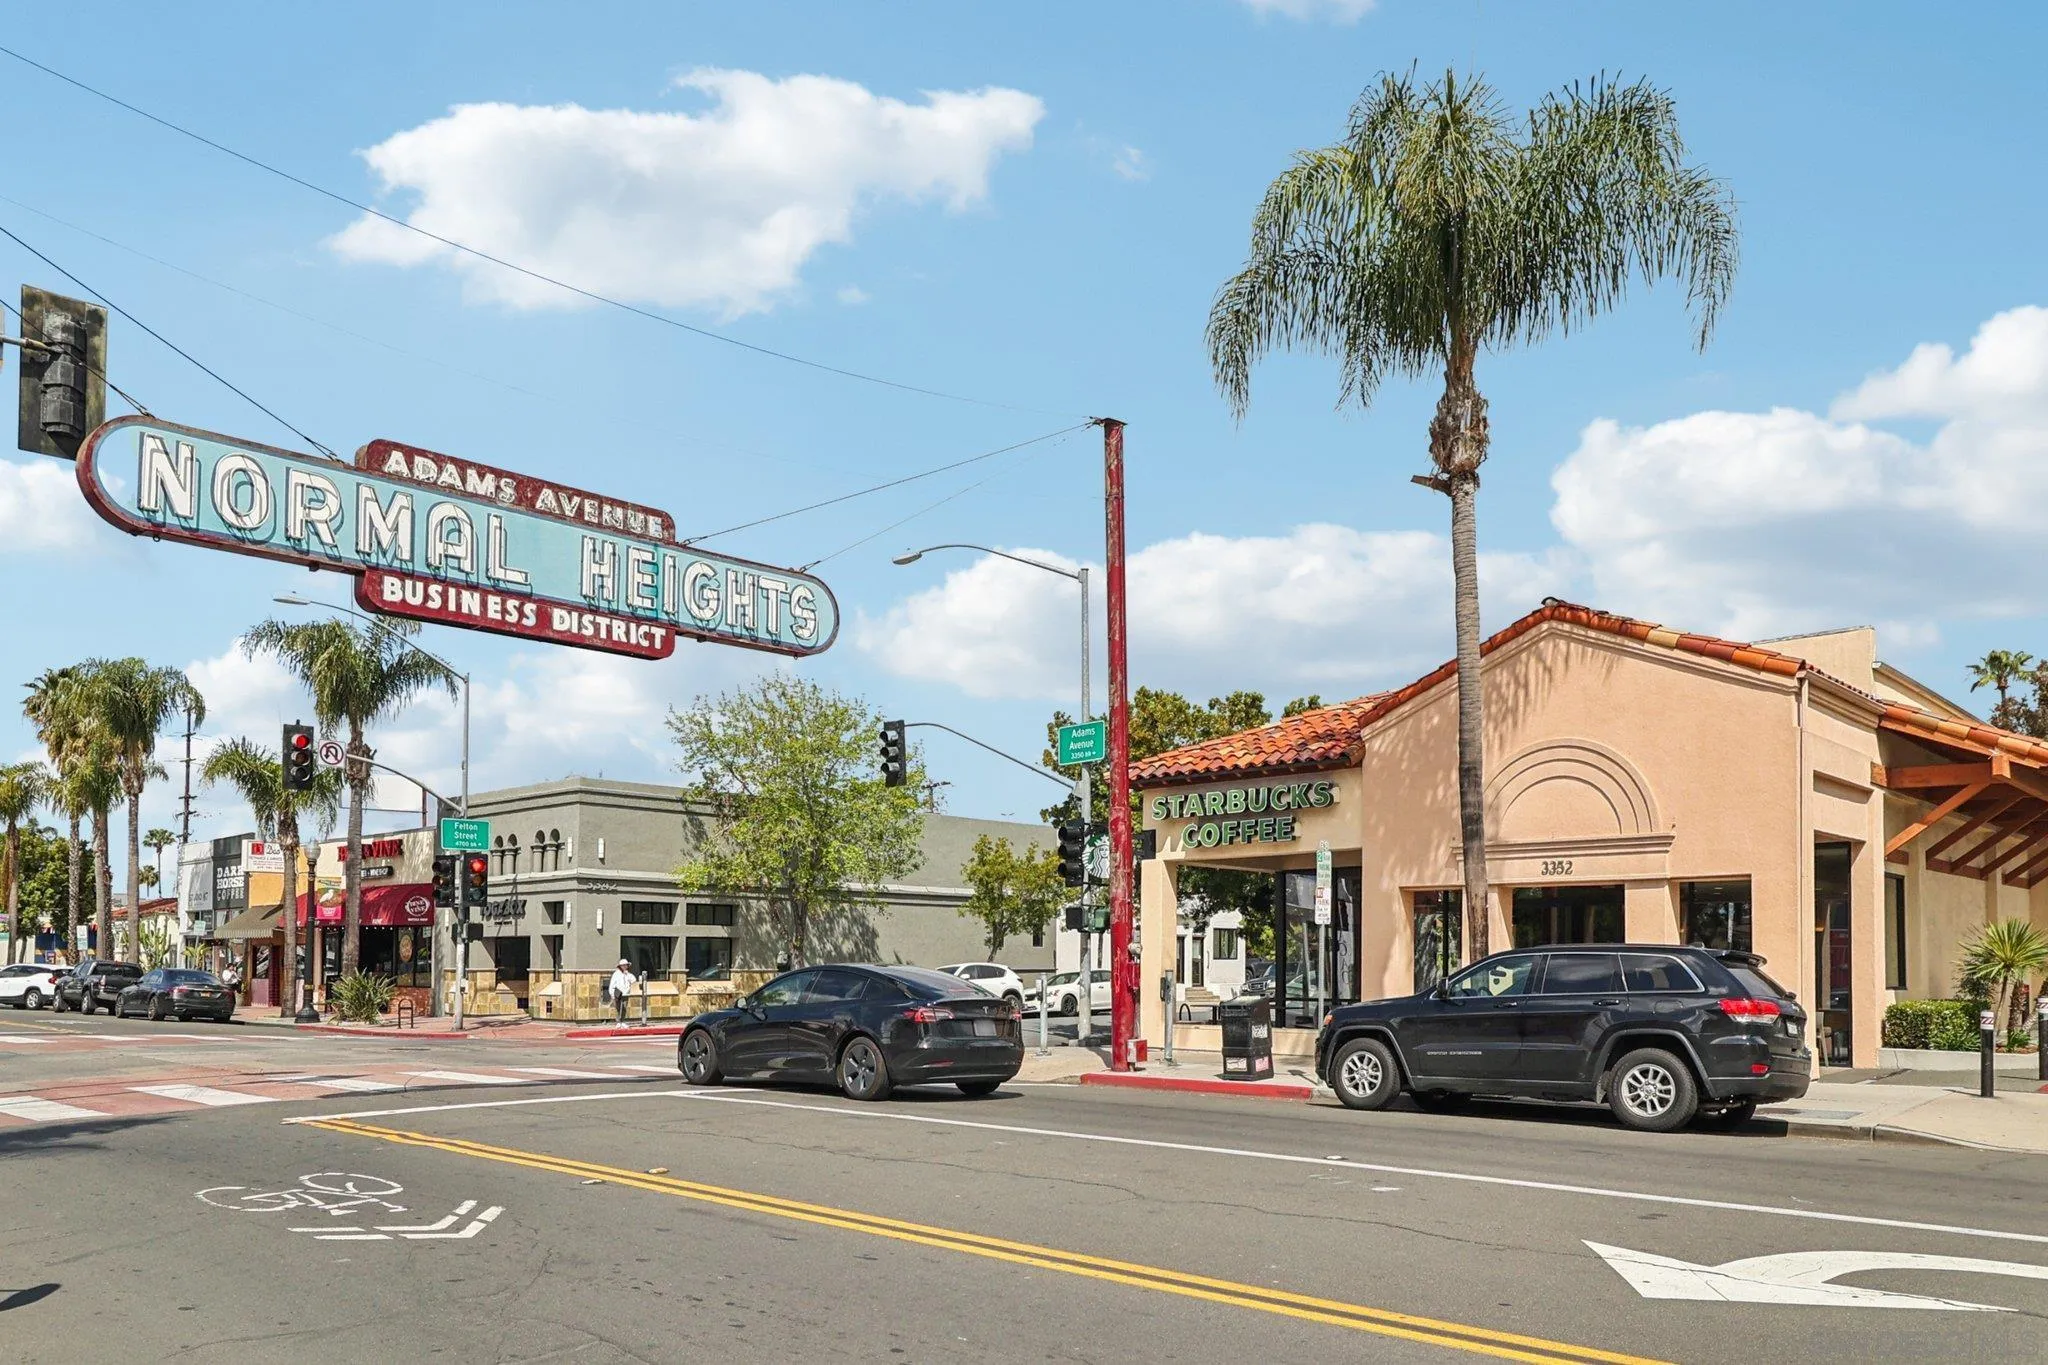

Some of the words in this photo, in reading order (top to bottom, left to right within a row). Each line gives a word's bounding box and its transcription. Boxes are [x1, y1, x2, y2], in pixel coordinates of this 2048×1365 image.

[381, 450, 517, 503] ADAMS
[534, 487, 664, 539] AVENUE
[138, 431, 532, 585] NORMAL
[581, 534, 819, 641] HEIGHTS
[383, 575, 537, 627] BUSINESS
[552, 608, 666, 651] DISTRICT
[1072, 728, 1096, 739] Adams
[1069, 739, 1095, 751] Avenue
[1151, 780, 1335, 821] STARBUCKS
[454, 822, 478, 831] Felton
[1182, 816, 1296, 849] COFFEE
[454, 831, 478, 840] Street
[1541, 860, 1573, 875] 3352
[216, 877, 245, 889] HORSE
[216, 887, 245, 902] COFFEE
